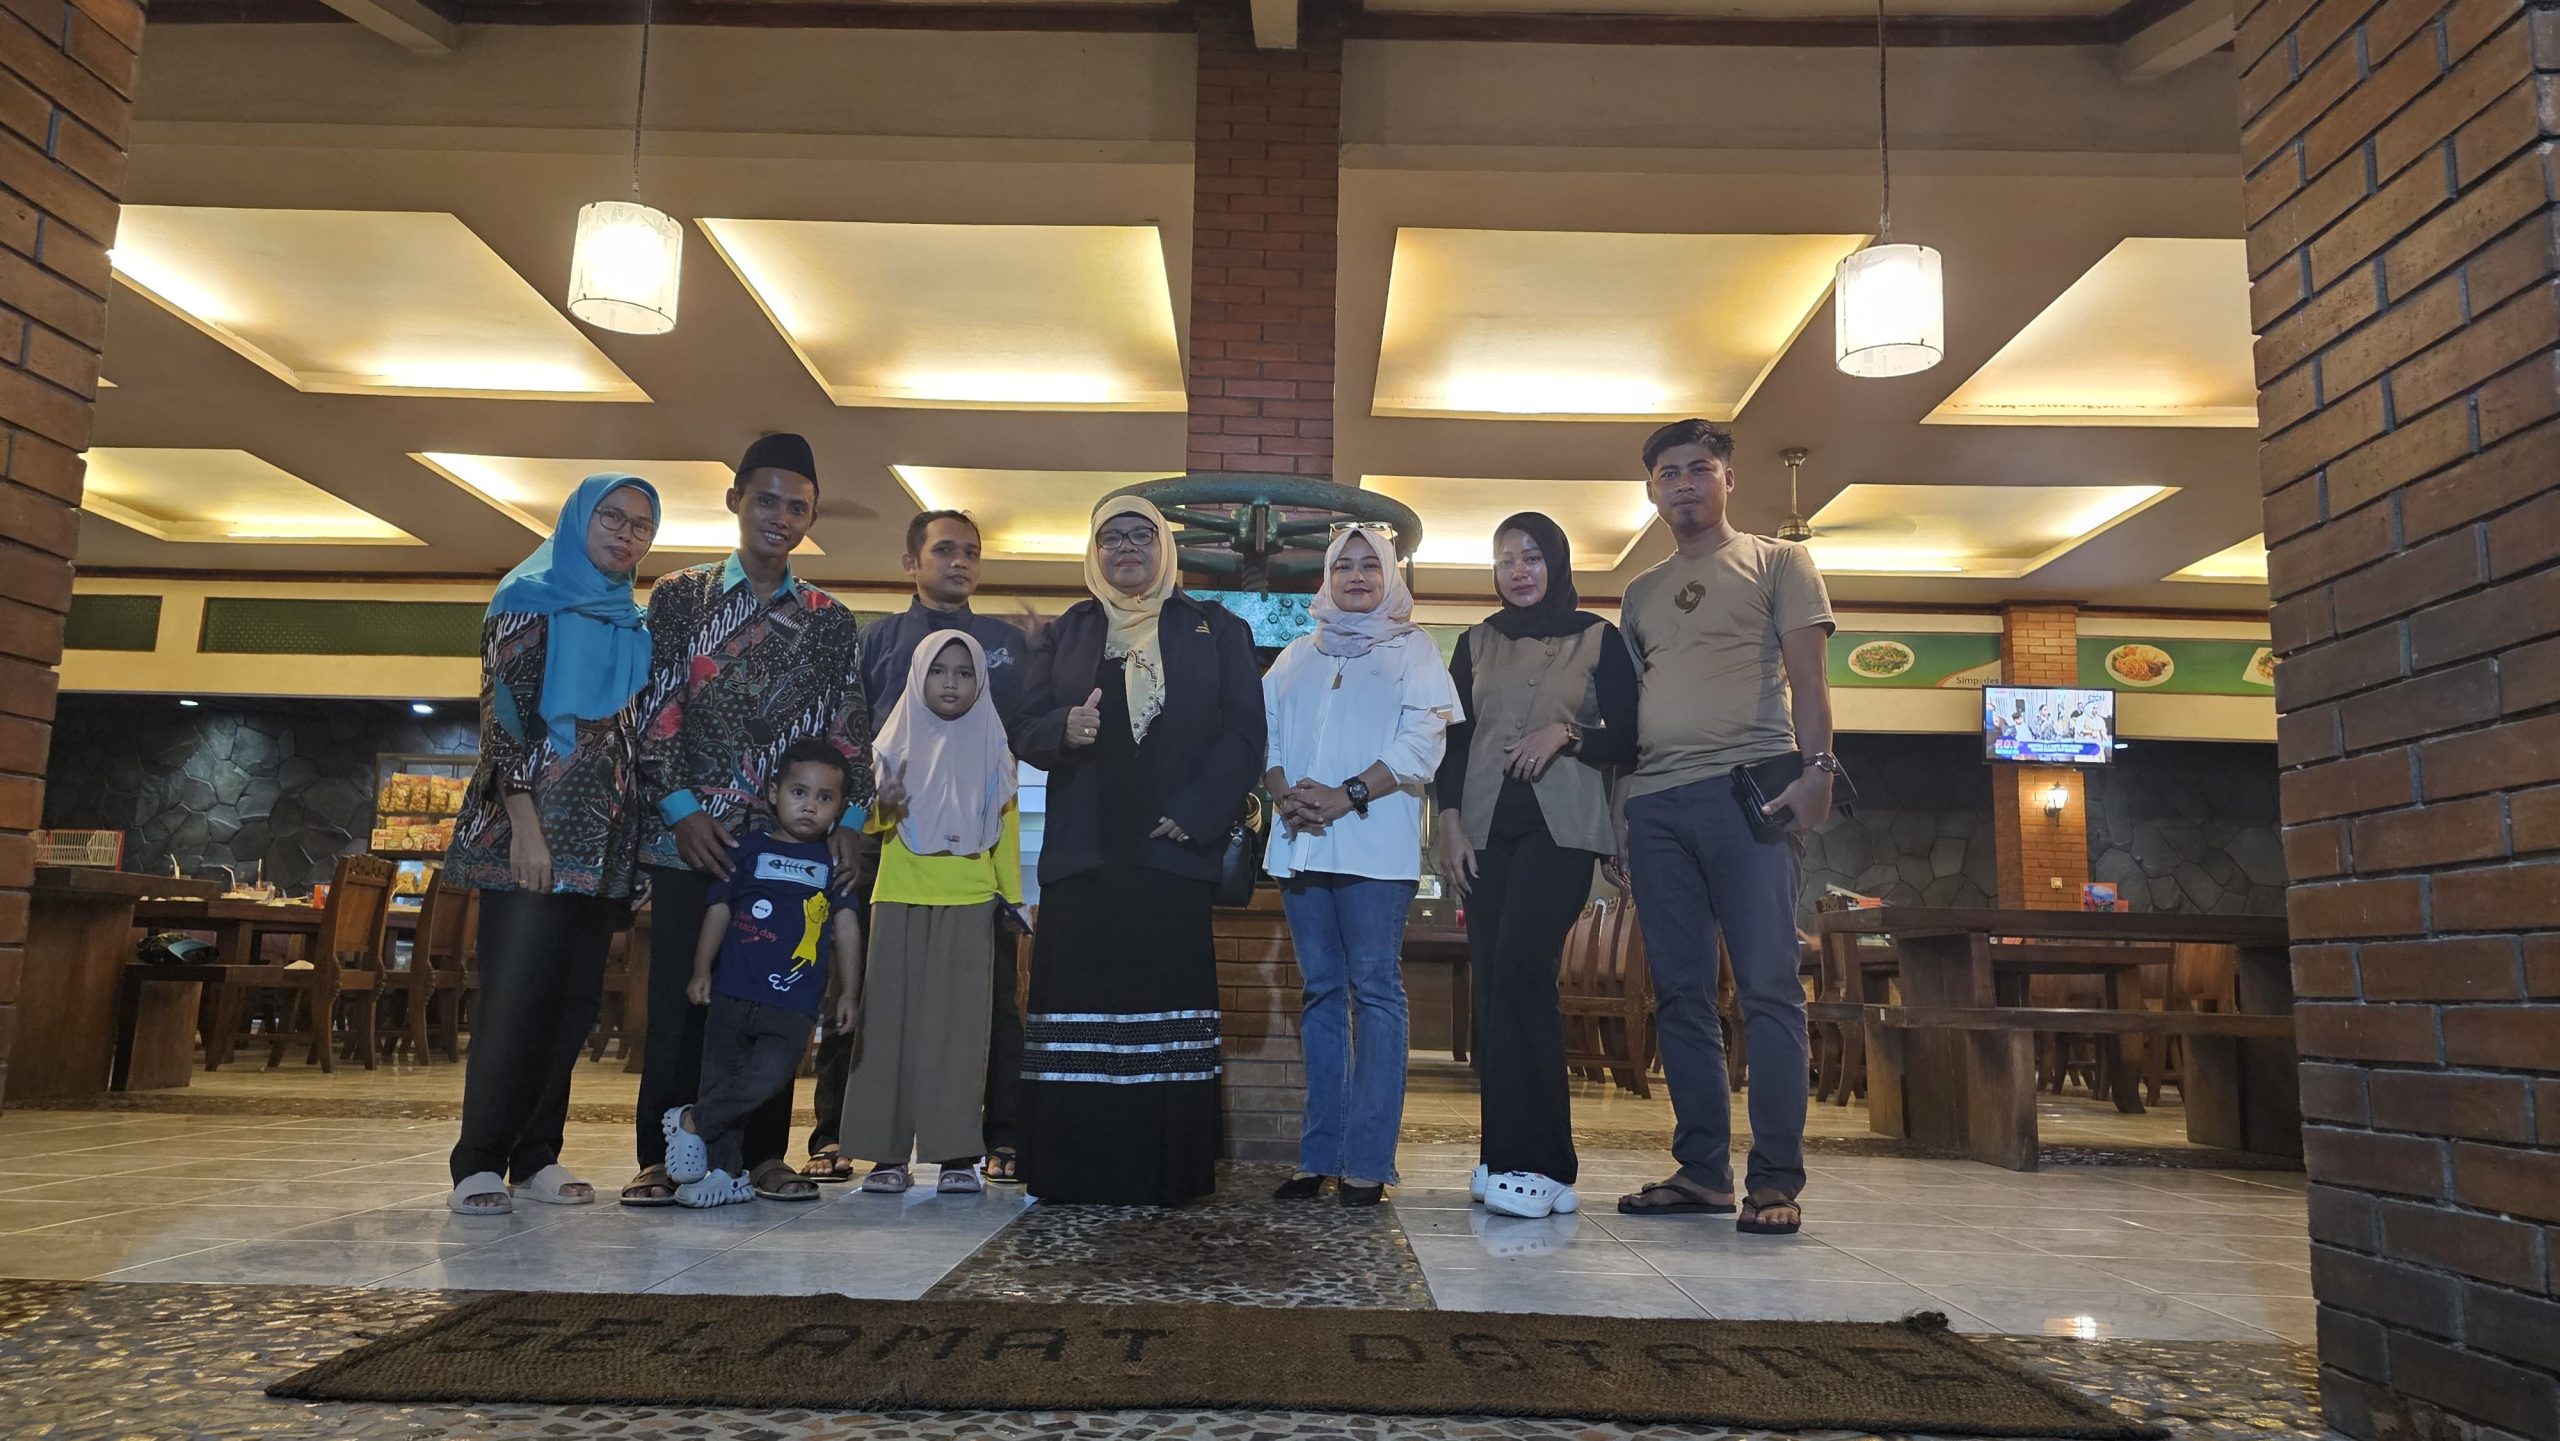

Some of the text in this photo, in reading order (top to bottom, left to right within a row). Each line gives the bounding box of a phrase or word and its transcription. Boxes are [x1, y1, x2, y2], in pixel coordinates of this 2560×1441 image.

[759, 928, 778, 942] day
[428, 1316, 1986, 1384] SELAMAT DATANG
